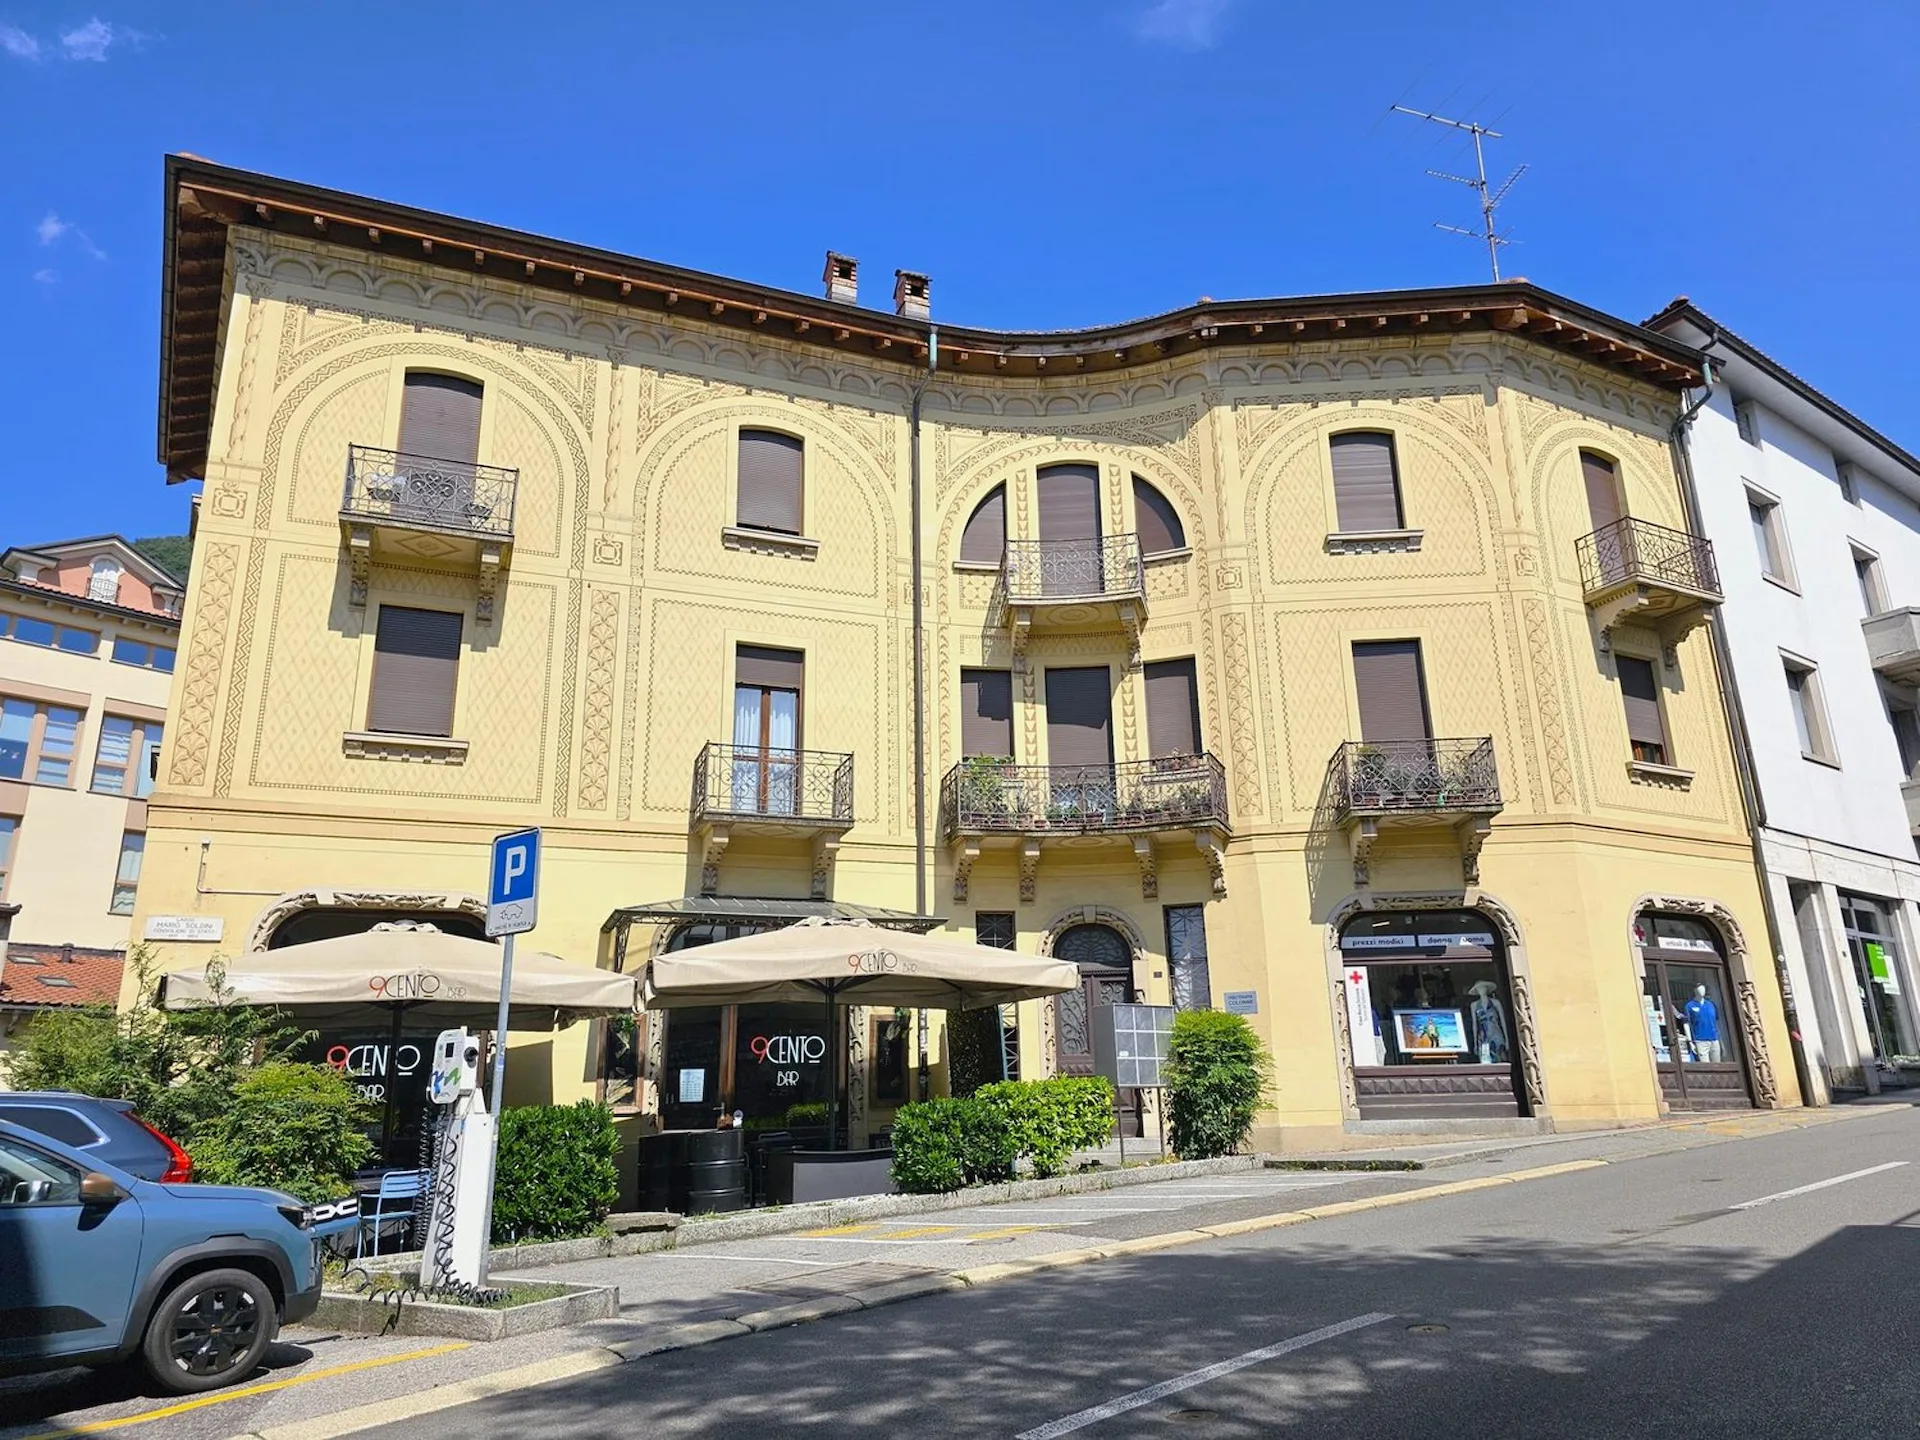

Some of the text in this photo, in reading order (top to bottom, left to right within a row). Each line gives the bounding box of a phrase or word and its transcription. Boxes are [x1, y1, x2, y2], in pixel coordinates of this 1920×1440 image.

[503, 845, 527, 896] P
[1352, 937, 1404, 947] prezzi modici
[1427, 937, 1452, 945] donna
[847, 952, 898, 974] 9CENTO
[369, 974, 441, 998] 9CENTO
[327, 1045, 421, 1077] 9CENO
[750, 1035, 826, 1064] 9CENTO
[776, 1071, 800, 1086] BAR
